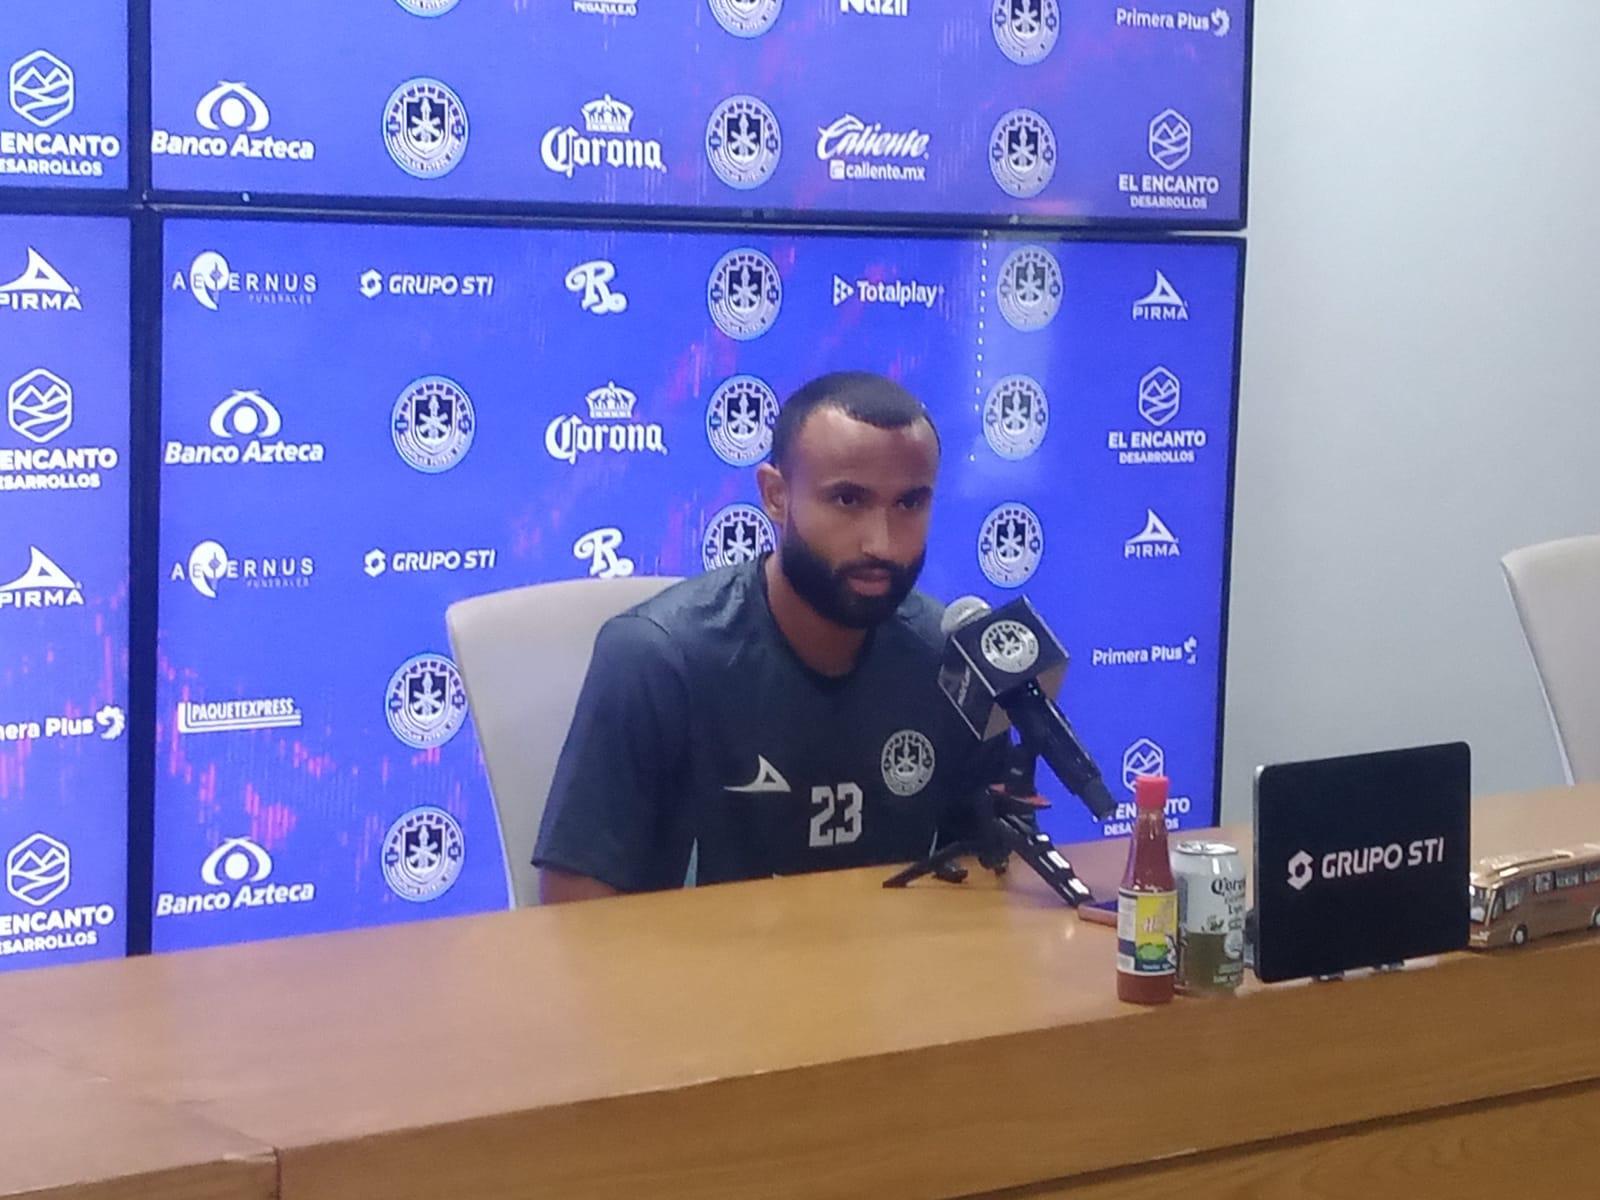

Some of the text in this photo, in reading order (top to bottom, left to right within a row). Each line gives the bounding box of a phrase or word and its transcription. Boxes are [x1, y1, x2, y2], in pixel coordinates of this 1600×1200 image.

[1116, 7, 1209, 31] Primera Plus
[0, 131, 120, 158] ENCANTO
[151, 129, 316, 161] Banco Azteca
[540, 125, 663, 178] Corona
[1118, 173, 1219, 194] EL ENCANTO
[388, 274, 495, 297] GRUPO STI
[856, 279, 939, 308] Totalplay
[1132, 304, 1188, 321] PIRMA
[545, 414, 663, 465] Corona
[1108, 430, 1206, 449] EL ENCANTO
[0, 447, 118, 471] ENCANTO
[164, 440, 325, 465] Banco Azteca
[392, 548, 497, 572] GRUPO STI
[1124, 543, 1180, 559] PIRMA
[1092, 645, 1183, 666] Primera Plus
[192, 697, 296, 720] PAQUETEXPRESS
[45, 716, 94, 737] Plus
[808, 782, 864, 848] 23
[1320, 837, 1445, 879] GRUPO STI
[156, 882, 316, 917] Banco Azteca
[0, 904, 115, 937] ENCANTO
